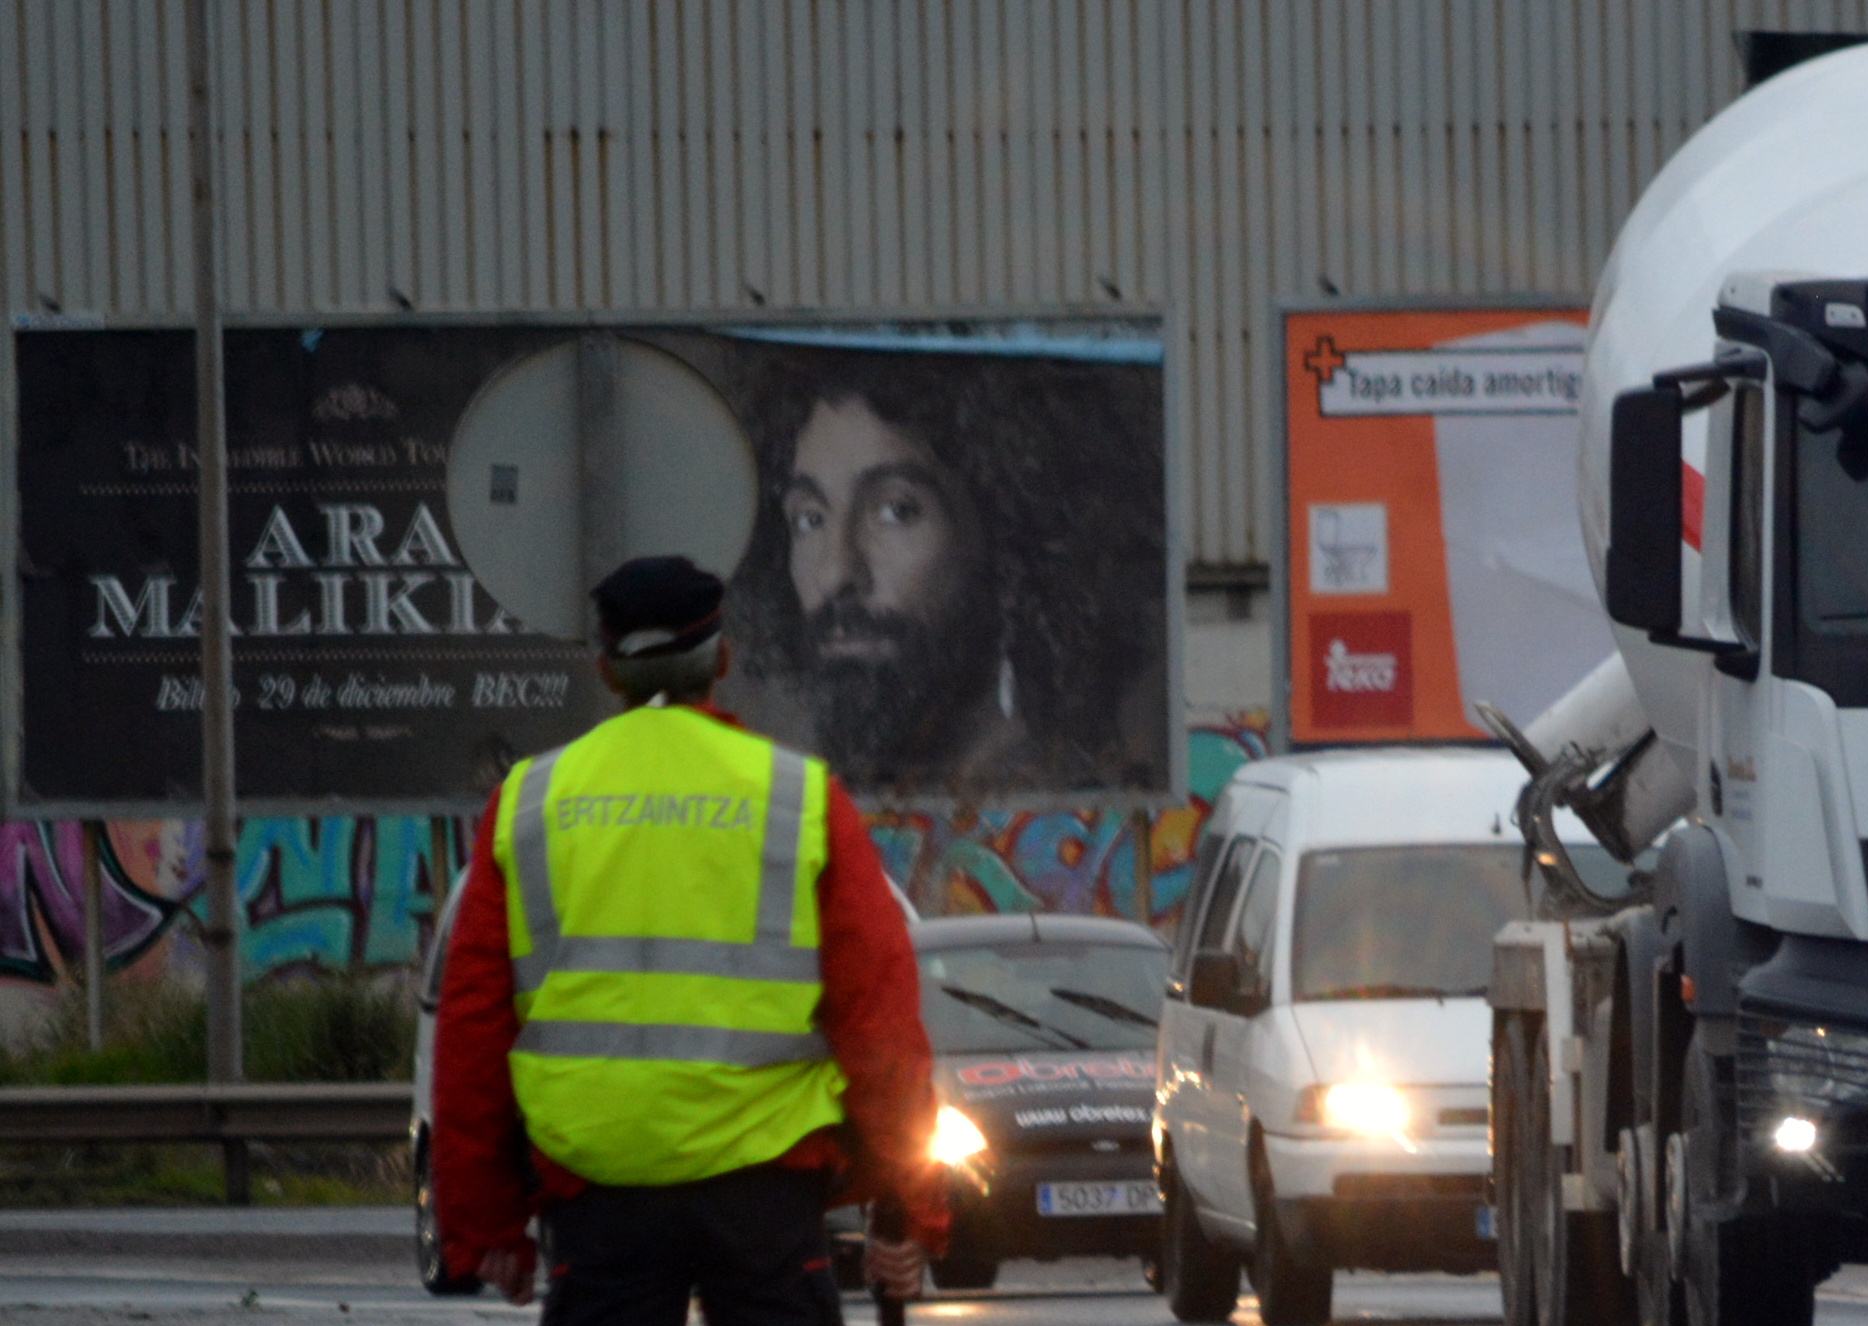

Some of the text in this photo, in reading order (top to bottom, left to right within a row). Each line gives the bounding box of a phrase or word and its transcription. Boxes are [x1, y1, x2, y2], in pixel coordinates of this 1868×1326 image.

[1347, 366, 1402, 402] Tapa
[245, 503, 458, 568] ARA
[258, 675, 296, 710] 29
[303, 674, 331, 708] de
[557, 794, 754, 832] ERTZAINTZA
